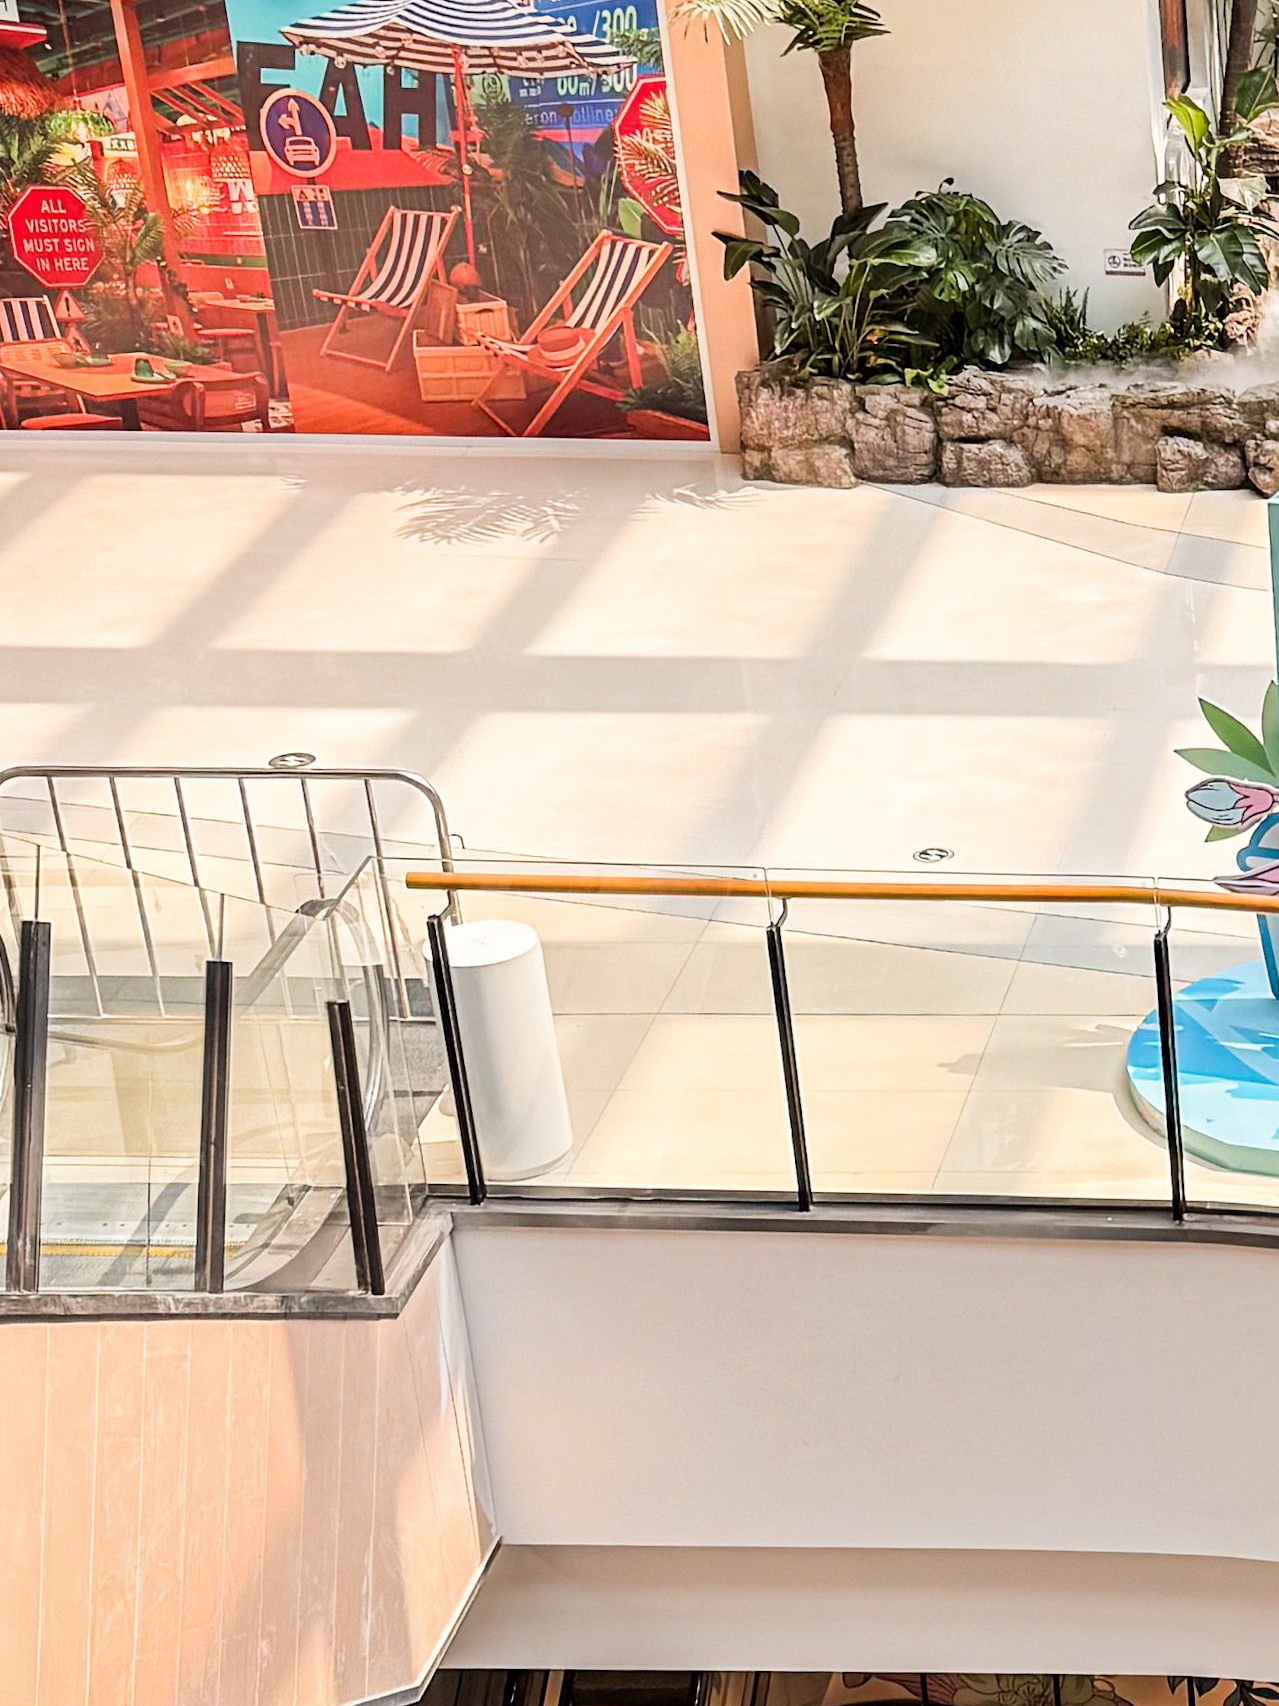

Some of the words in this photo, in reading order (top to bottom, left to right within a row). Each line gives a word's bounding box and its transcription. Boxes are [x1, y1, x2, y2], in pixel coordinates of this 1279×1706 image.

[41, 199, 67, 214] ALL
[25, 218, 87, 233] VISITORS
[23, 238, 60, 253] MUST
[64, 237, 95, 253] SIGN
[36, 257, 51, 272] IN
[54, 257, 90, 271] HERE
